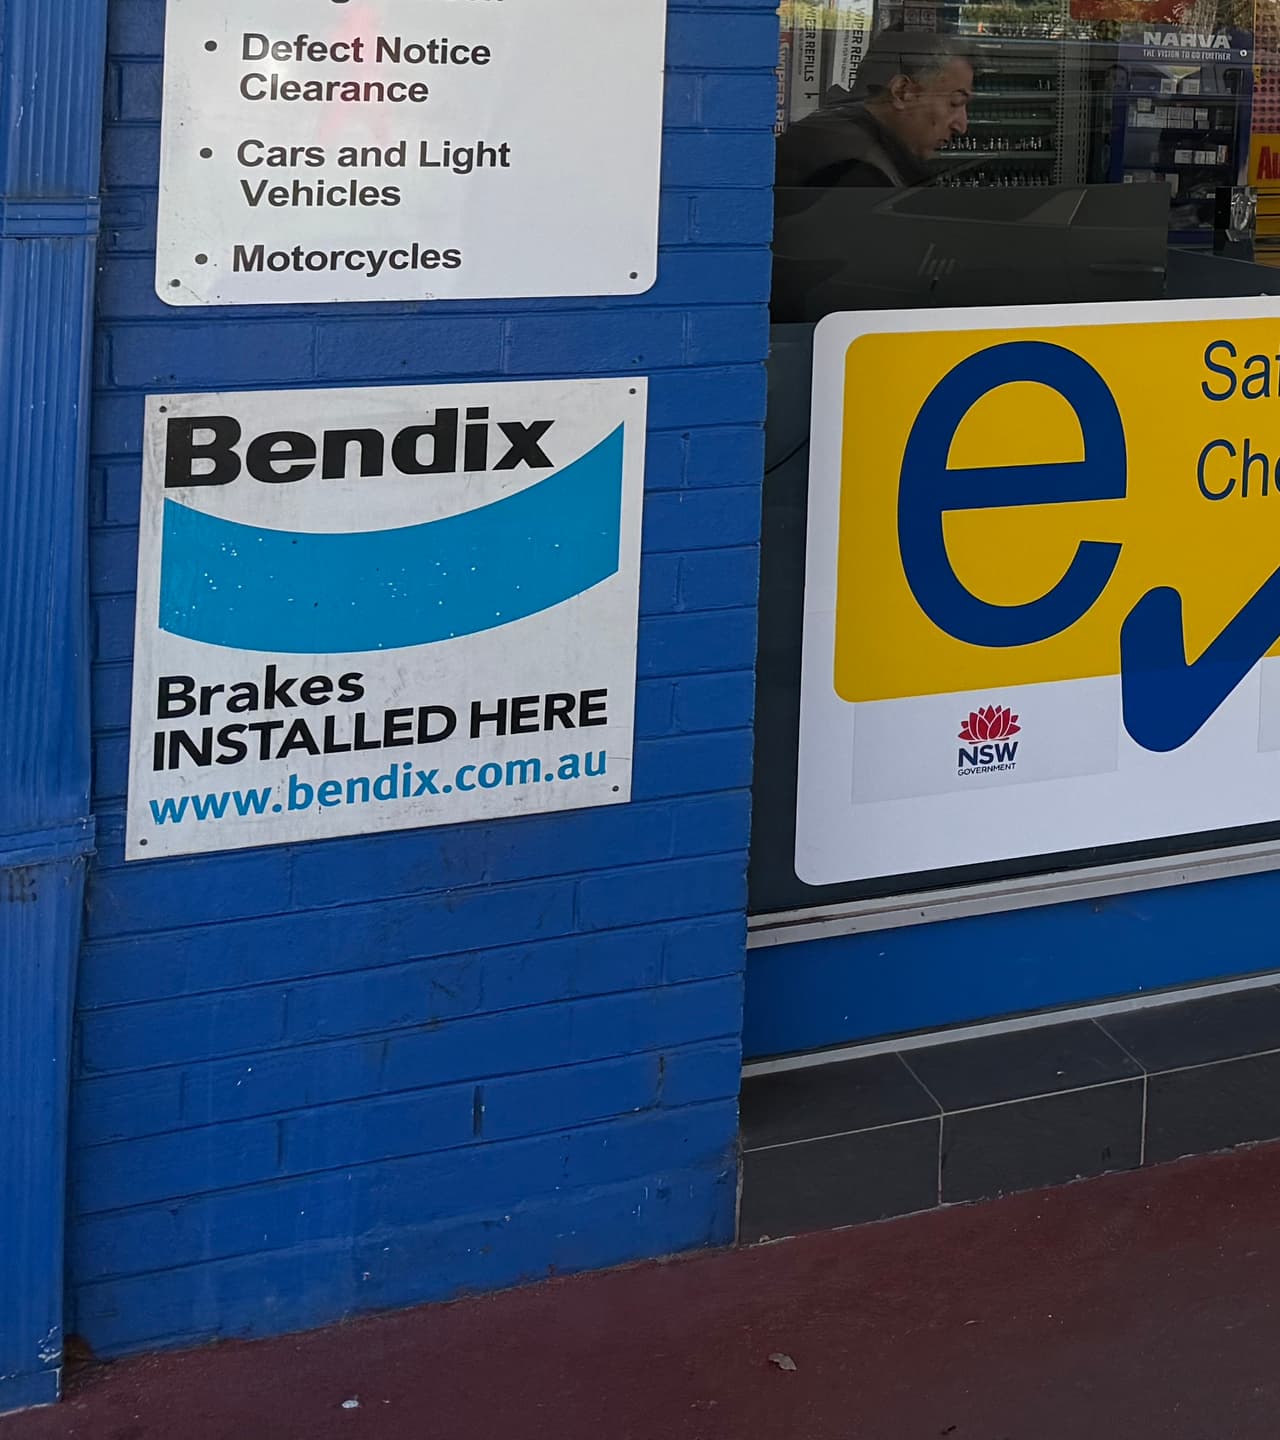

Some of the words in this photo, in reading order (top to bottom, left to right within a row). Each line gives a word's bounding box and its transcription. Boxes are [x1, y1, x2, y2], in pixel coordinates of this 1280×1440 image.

[804, 5, 818, 38] WIPER
[851, 7, 866, 44] WIPER
[241, 32, 364, 64] Defect
[375, 36, 492, 66] Notice
[1143, 31, 1232, 50] NARVA
[803, 41, 817, 82] REFILLS
[848, 46, 863, 90] REFILL
[238, 72, 430, 104] Clearance
[236, 138, 325, 169] Cars
[336, 141, 407, 168] and
[418, 141, 511, 175] Light
[239, 179, 402, 208] Vehicles
[232, 242, 462, 278] Motorcycles
[164, 406, 556, 489] Bendix
[897, 340, 1128, 648] e
[156, 664, 365, 720] Brakes
[152, 704, 458, 772] INSTALLED
[469, 688, 609, 740] HERE
[957, 741, 1019, 768] NSW
[957, 762, 1017, 777] GOVERNMENT
[148, 748, 608, 826] www.bendix.com.au
